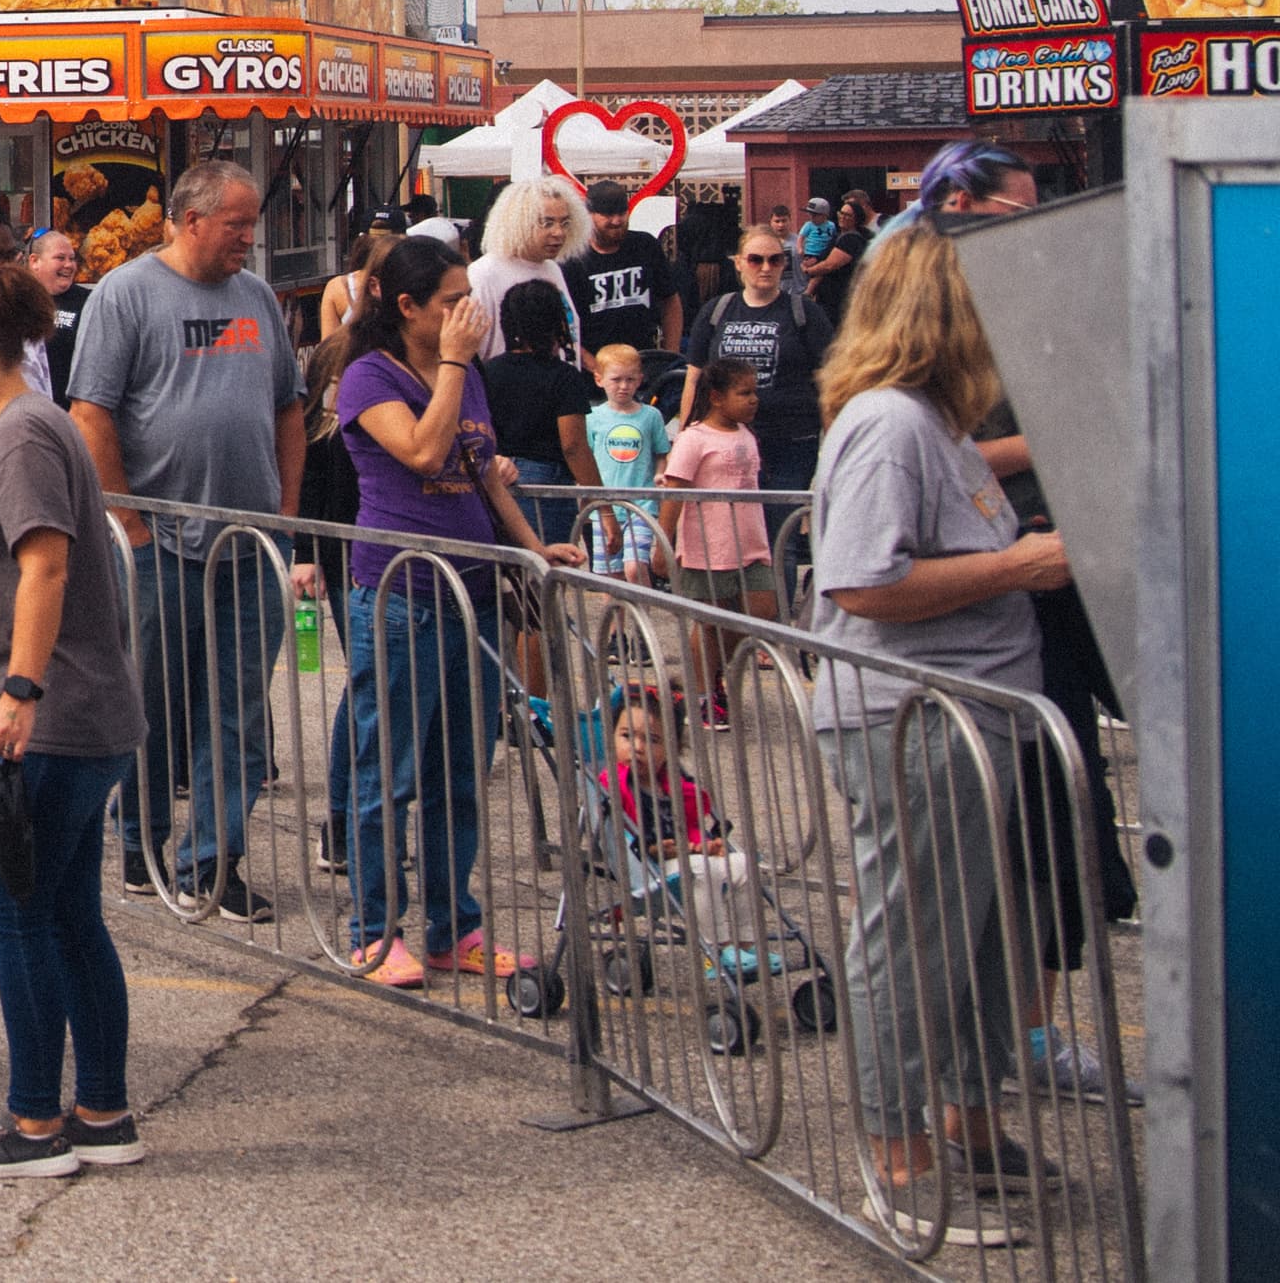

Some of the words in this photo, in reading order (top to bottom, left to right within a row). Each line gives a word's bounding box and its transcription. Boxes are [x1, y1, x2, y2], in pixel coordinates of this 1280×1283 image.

[218, 39, 274, 53] CLASSIC
[997, 49, 1028, 67] Ice
[1035, 42, 1087, 64] Cold
[1152, 43, 1195, 72] Foot
[163, 56, 303, 91] GYROS
[318, 59, 368, 94] CHICKEN
[384, 68, 413, 97] FRENCH
[414, 71, 435, 99] FRIES
[973, 64, 1114, 107] DRINKS
[1153, 68, 1200, 97] Long
[448, 75, 481, 102] PICKLES
[75, 120, 138, 132] POPCORN
[56, 130, 157, 154] CHICKEN
[593, 267, 643, 304] SRC
[183, 318, 261, 347] MSR
[724, 325, 777, 334] SMOOTH
[608, 439, 632, 448] Hurley
